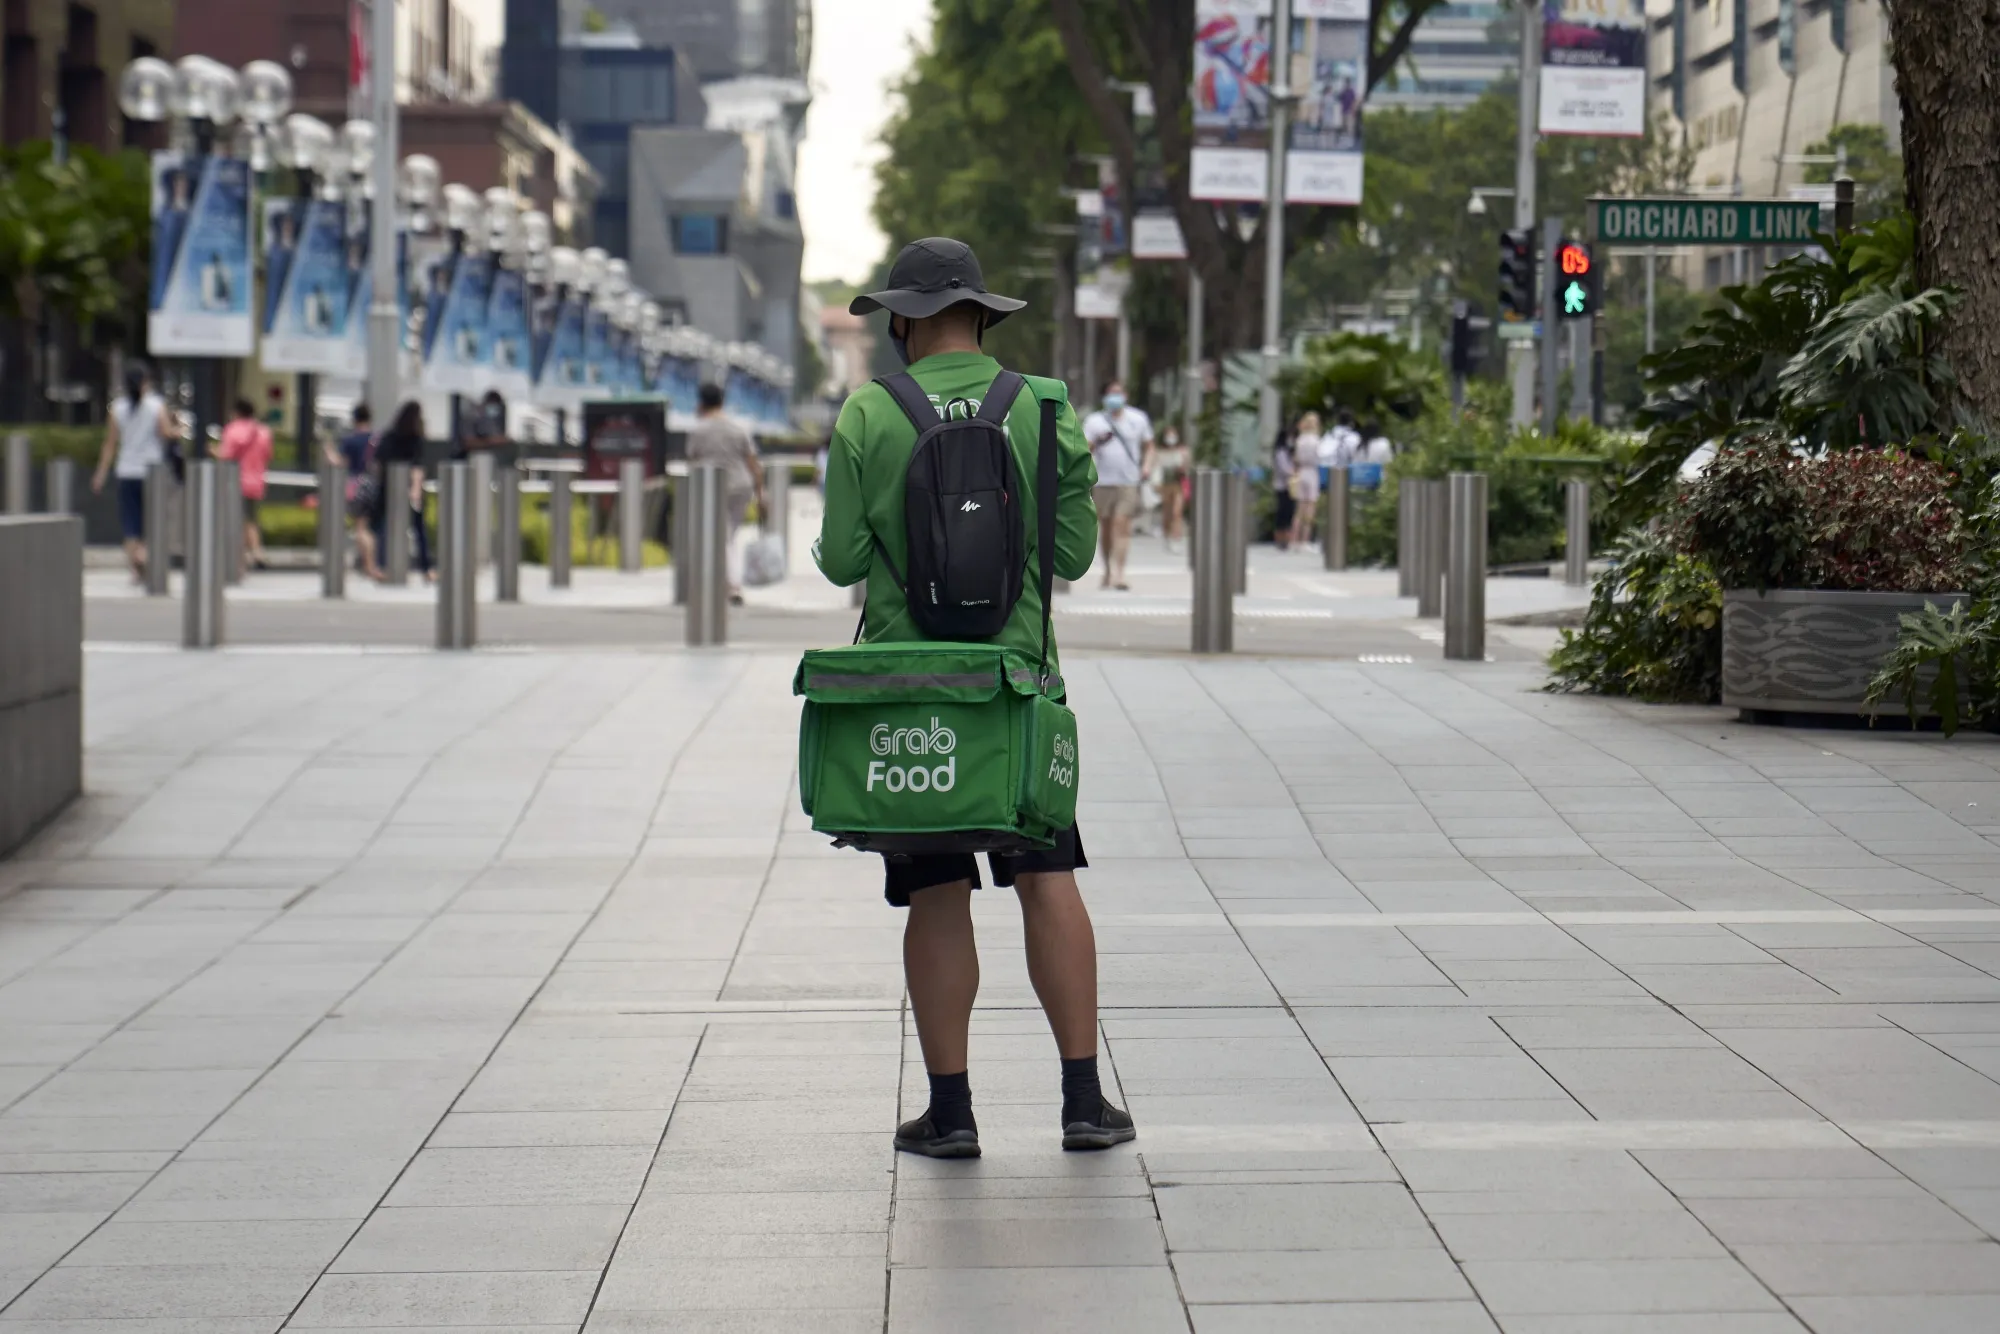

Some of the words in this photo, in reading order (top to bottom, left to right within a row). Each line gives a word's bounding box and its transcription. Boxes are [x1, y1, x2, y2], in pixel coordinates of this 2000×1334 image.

[1604, 204, 1738, 237] ORCHARD
[1749, 207, 1812, 239] LINK
[1562, 244, 1590, 274] 05
[870, 716, 957, 756] Grab
[1053, 733, 1075, 764] Grab
[866, 756, 956, 793] Food
[1048, 757, 1073, 788] Food
